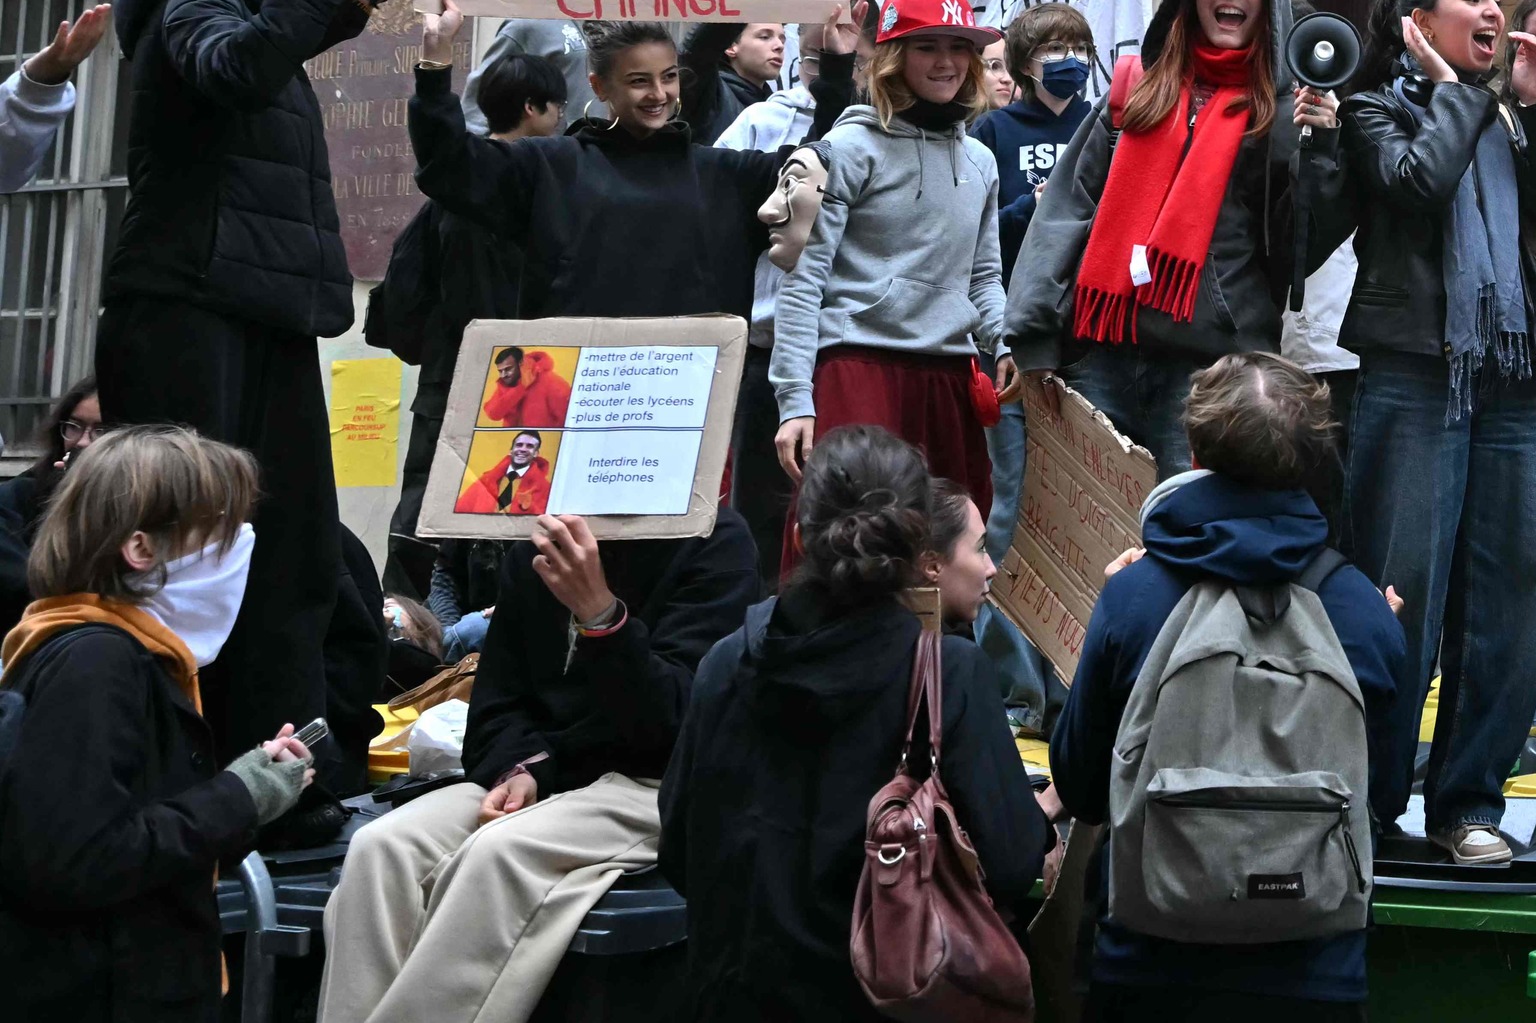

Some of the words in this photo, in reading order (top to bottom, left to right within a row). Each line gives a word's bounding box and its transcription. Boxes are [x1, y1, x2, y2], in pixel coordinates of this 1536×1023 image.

[354, 173, 391, 198] VILLE
[585, 353, 626, 362] -mettre
[630, 351, 645, 361] de
[648, 350, 694, 363] l'argent
[581, 367, 610, 377] dans
[613, 365, 679, 376] l'éducation
[577, 381, 631, 392] nationale
[575, 397, 625, 407] -écouter
[627, 396, 644, 406] les
[647, 395, 694, 408] lycéens
[572, 412, 602, 424] -plus
[604, 412, 619, 422] de
[622, 410, 654, 423] profs
[588, 456, 638, 467] Interdire
[641, 456, 659, 467] les
[587, 470, 654, 484] téléphones
[1055, 612, 1087, 658] NOU
[1258, 881, 1299, 891] EASTPAK
